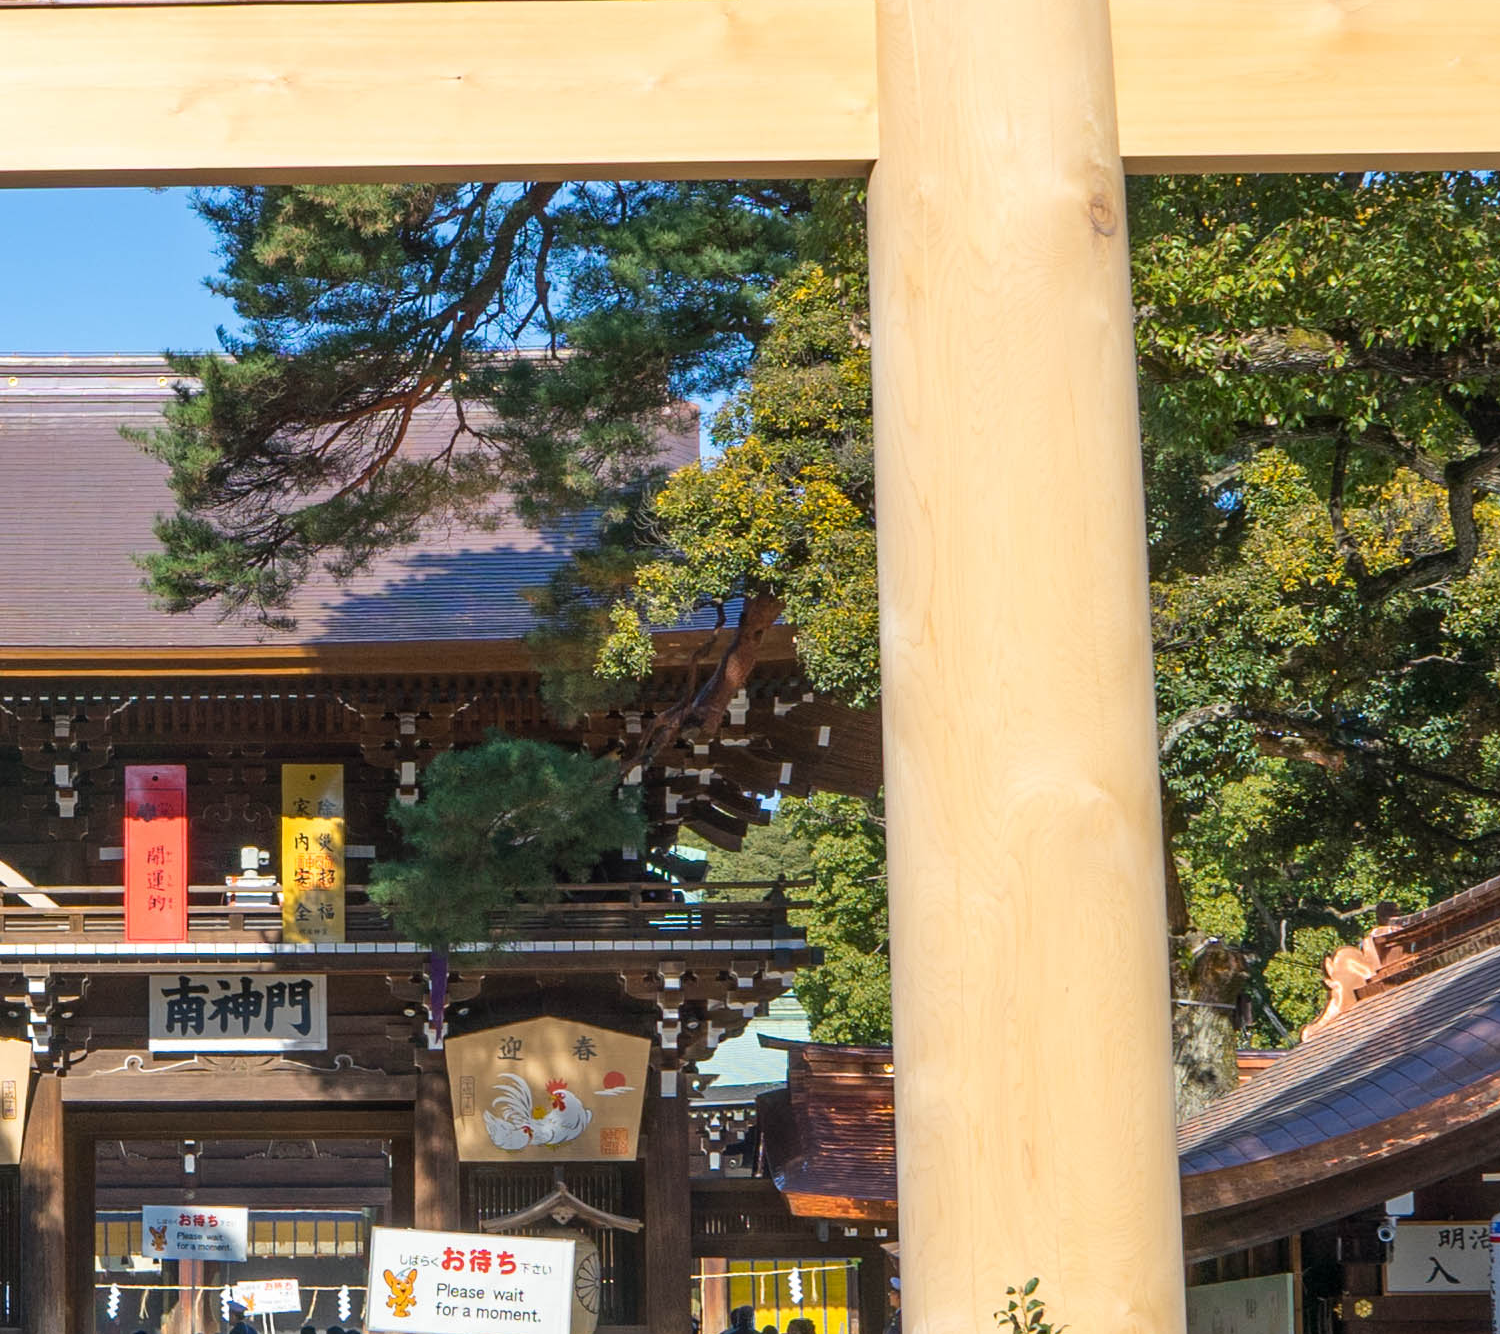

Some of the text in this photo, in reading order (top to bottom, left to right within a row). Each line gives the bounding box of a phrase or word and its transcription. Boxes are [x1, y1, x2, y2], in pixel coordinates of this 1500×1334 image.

[293, 798, 312, 921] 家内安全
[317, 798, 336, 920] 除災招福
[147, 844, 166, 912] 開運的
[161, 975, 314, 1036] 南神門
[497, 1035, 598, 1062] 迎春
[177, 1232, 202, 1241] Please
[400, 1246, 552, 1276] しばらくお待ち下さい
[436, 1283, 524, 1303] Please wait
[435, 1302, 541, 1323] for a moment.
